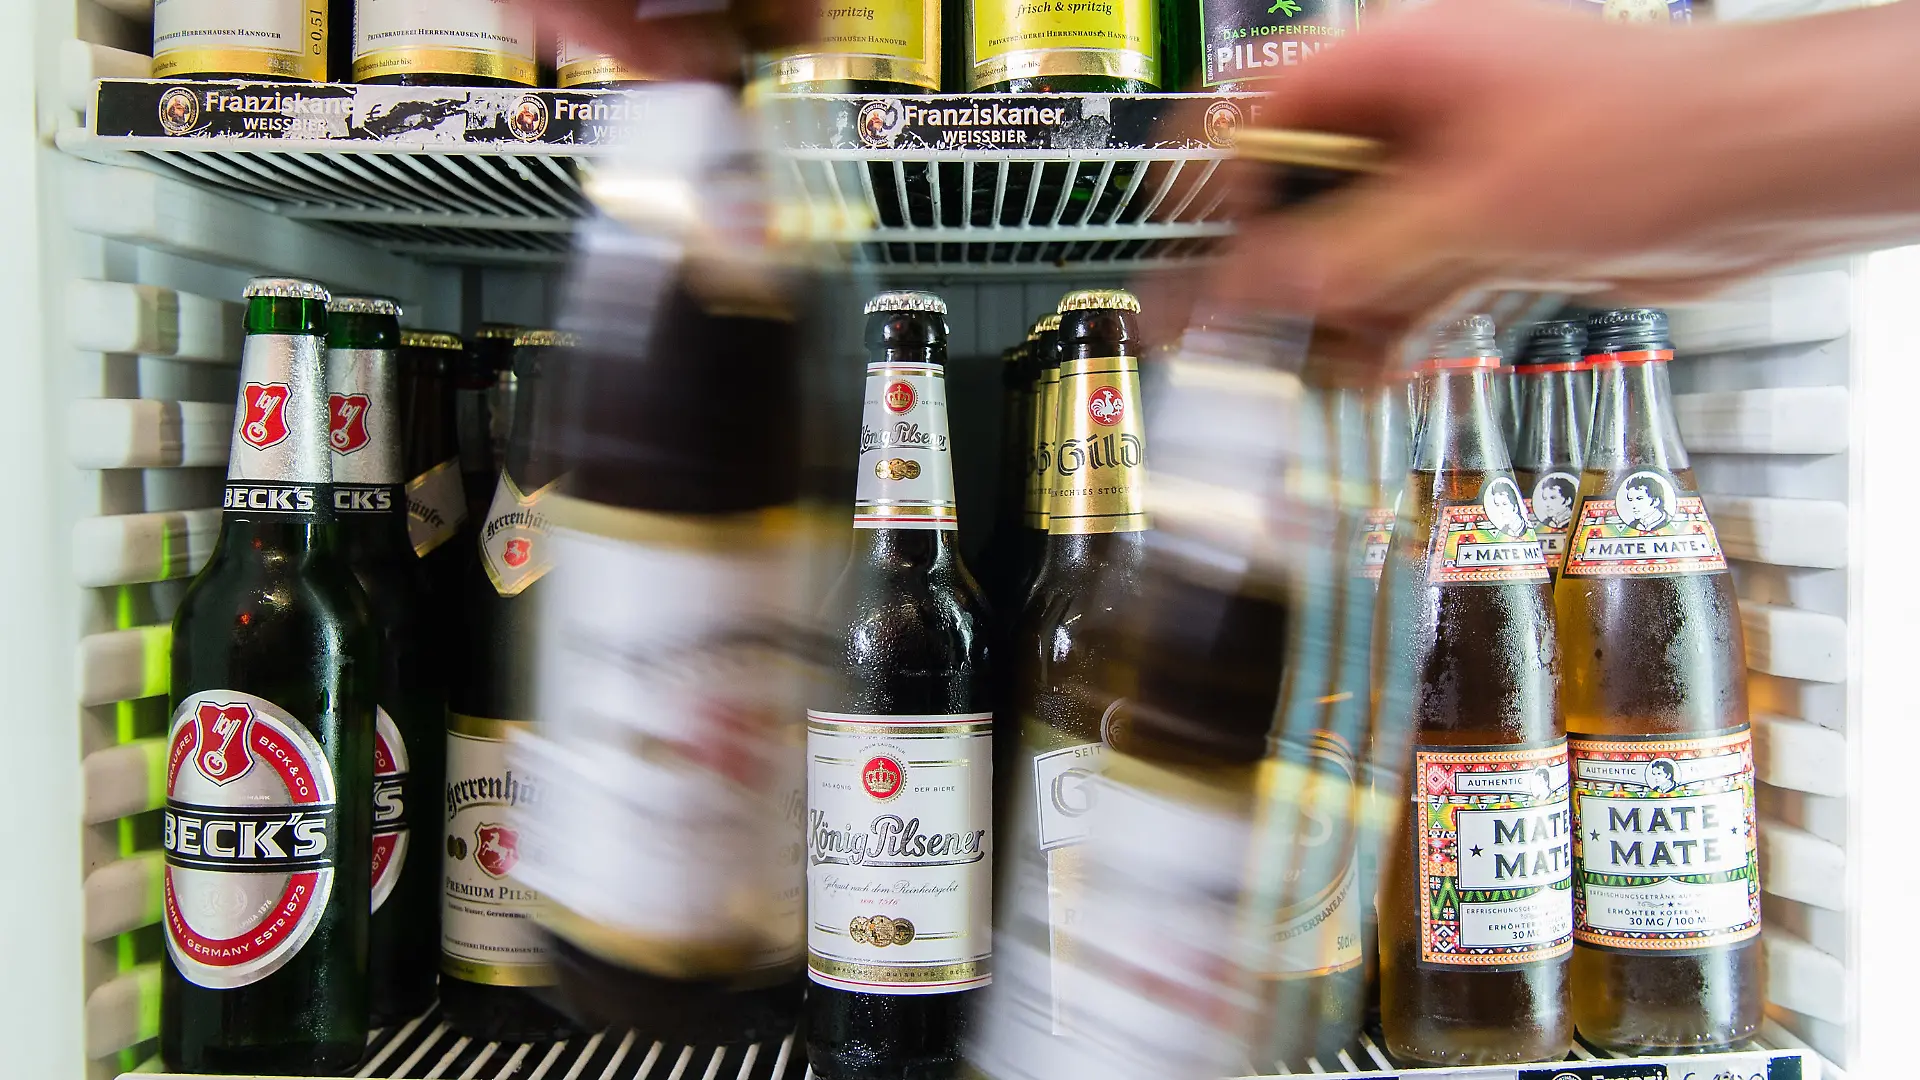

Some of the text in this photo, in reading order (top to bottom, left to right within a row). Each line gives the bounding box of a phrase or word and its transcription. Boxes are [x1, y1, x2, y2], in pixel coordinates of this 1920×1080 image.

[827, 7, 874, 20] spritzig
[1015, 1, 1112, 18] frisch & spritzig
[237, 29, 282, 39] HANNOVER
[418, 28, 480, 38] HERRENHAUSEN
[480, 32, 518, 44] HANNOVER
[868, 36, 907, 46] HANNOVER
[1046, 30, 1107, 38] HERRENHAUSEN
[1223, 28, 1248, 40] DAS
[1217, 41, 1336, 72] PILSEN
[206, 91, 354, 114] Franziskane
[554, 99, 643, 120] Franzis
[904, 104, 1066, 126] Franziskaner
[243, 117, 328, 131] WEISSBIER
[942, 130, 1027, 144] WEISSBIER
[1057, 433, 1143, 477] Gild
[224, 486, 314, 510] BECK'S
[334, 488, 392, 510] CK'S
[1476, 548, 1520, 561] MATE
[1598, 541, 1698, 556] MATE MATE
[1074, 746, 1101, 758] SEIT
[1586, 766, 1637, 775] AUTHENTIC
[1468, 778, 1523, 787] AUTHENTIC
[1494, 808, 1570, 844] MATE
[1608, 804, 1720, 834] MATE
[165, 812, 327, 859] BECK'S
[809, 808, 986, 867] König Pilsener
[1610, 838, 1722, 868] MATE
[1494, 842, 1570, 881] MATE
[446, 877, 494, 899] PREMIUM
[850, 883, 869, 895] nach
[871, 882, 890, 894] dem
[1270, 887, 1347, 943] EDITERRANEAN
[1607, 908, 1656, 916] ERHÖHTER
[187, 938, 250, 957] GERMANY
[282, 884, 306, 917] 1873
[1629, 918, 1642, 926] 30
[1645, 918, 1664, 926] MG
[1675, 917, 1694, 926] 100
[1512, 931, 1524, 940] 30
